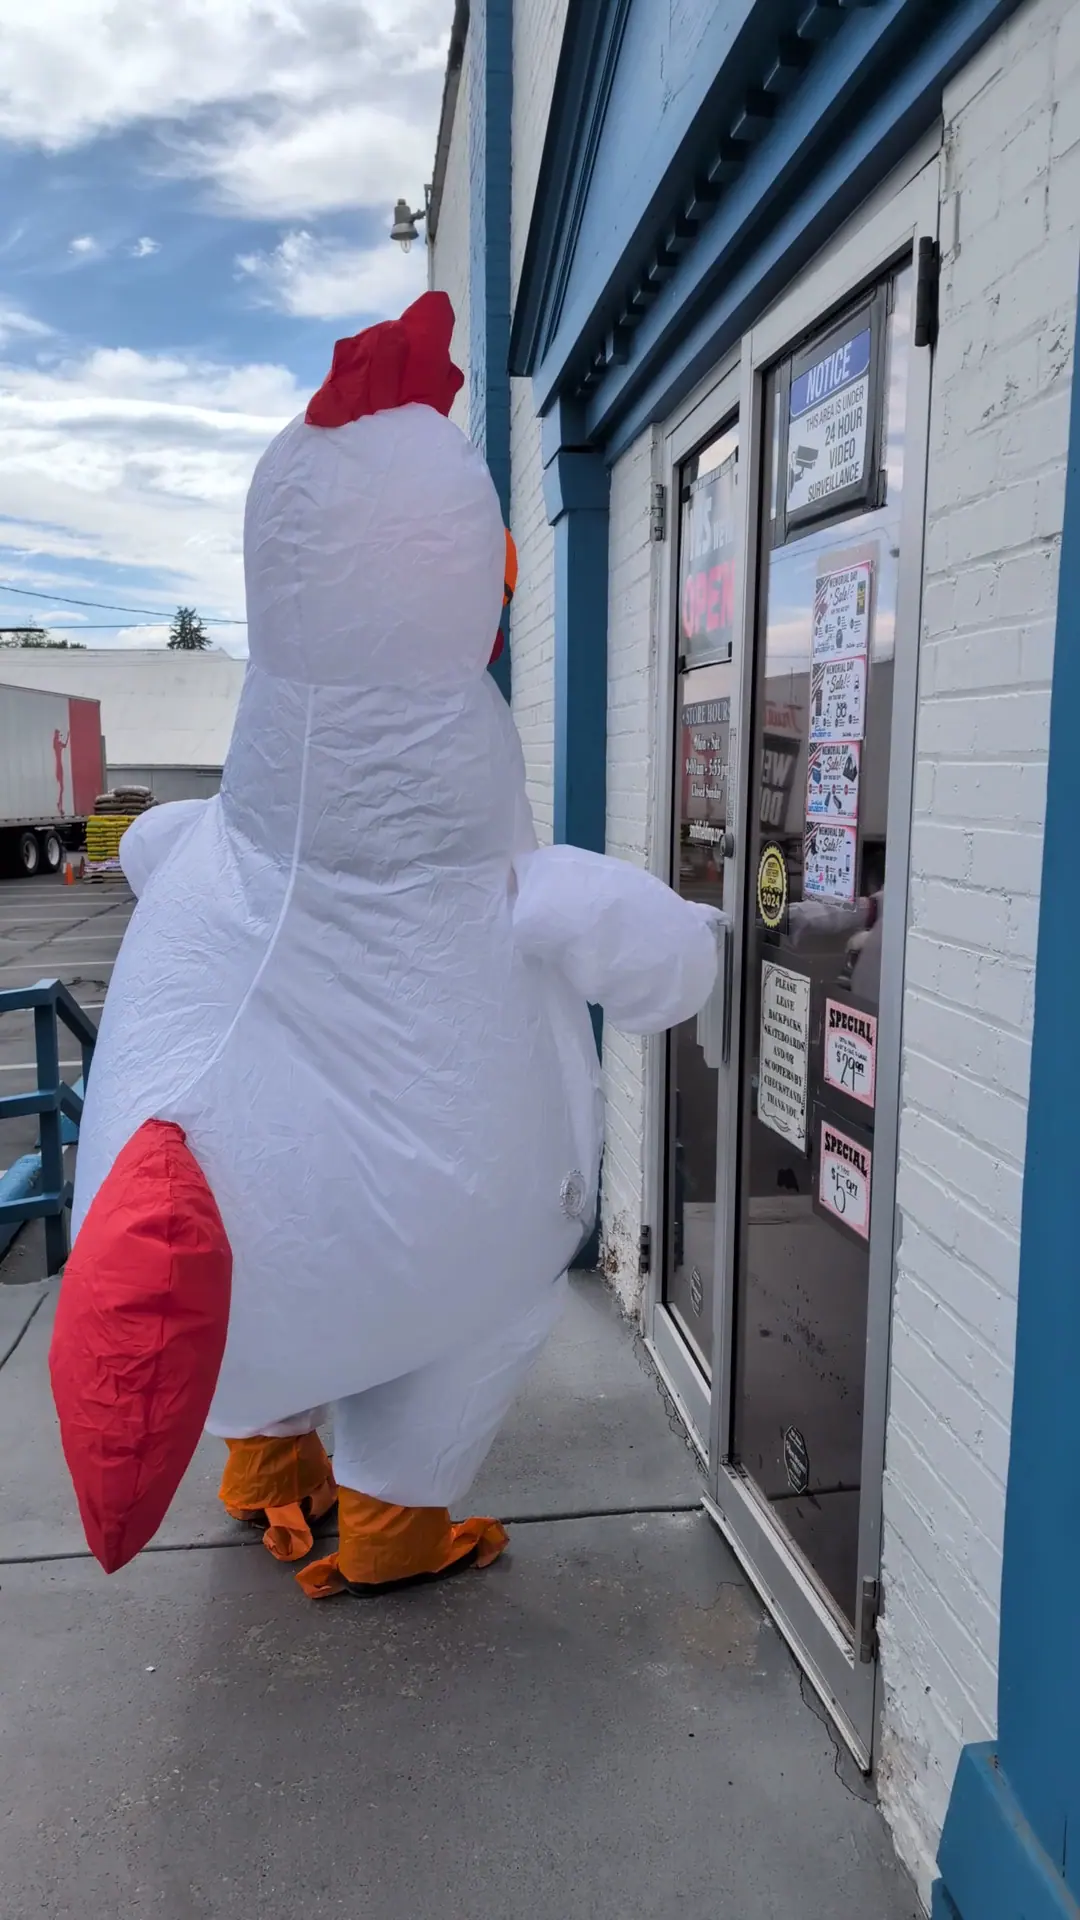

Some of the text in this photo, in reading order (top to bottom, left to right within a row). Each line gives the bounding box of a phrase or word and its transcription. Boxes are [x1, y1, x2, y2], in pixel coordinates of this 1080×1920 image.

[806, 341, 852, 404] NOTICE
[806, 385, 864, 433] THIS AREA IS UNDER
[825, 406, 863, 447] 24 HOUR
[829, 438, 856, 470] VIDEO
[807, 461, 860, 502] SURVEILLANCE
[682, 558, 735, 639] OPEN
[826, 660, 854, 674] MEMORIAL DAY
[685, 703, 705, 725] STORE
[711, 732, 721, 751] Sat
[691, 783, 722, 801] Closed Sunday
[762, 893, 780, 908] 2024
[774, 977, 797, 994] PLEASE
[776, 994, 795, 1011] LEAVE
[829, 1008, 873, 1046] SPECIAL
[764, 1057, 803, 1087] SCOOTERS BY
[767, 1091, 785, 1112] THANK
[825, 1131, 867, 1178] SPECIAL
